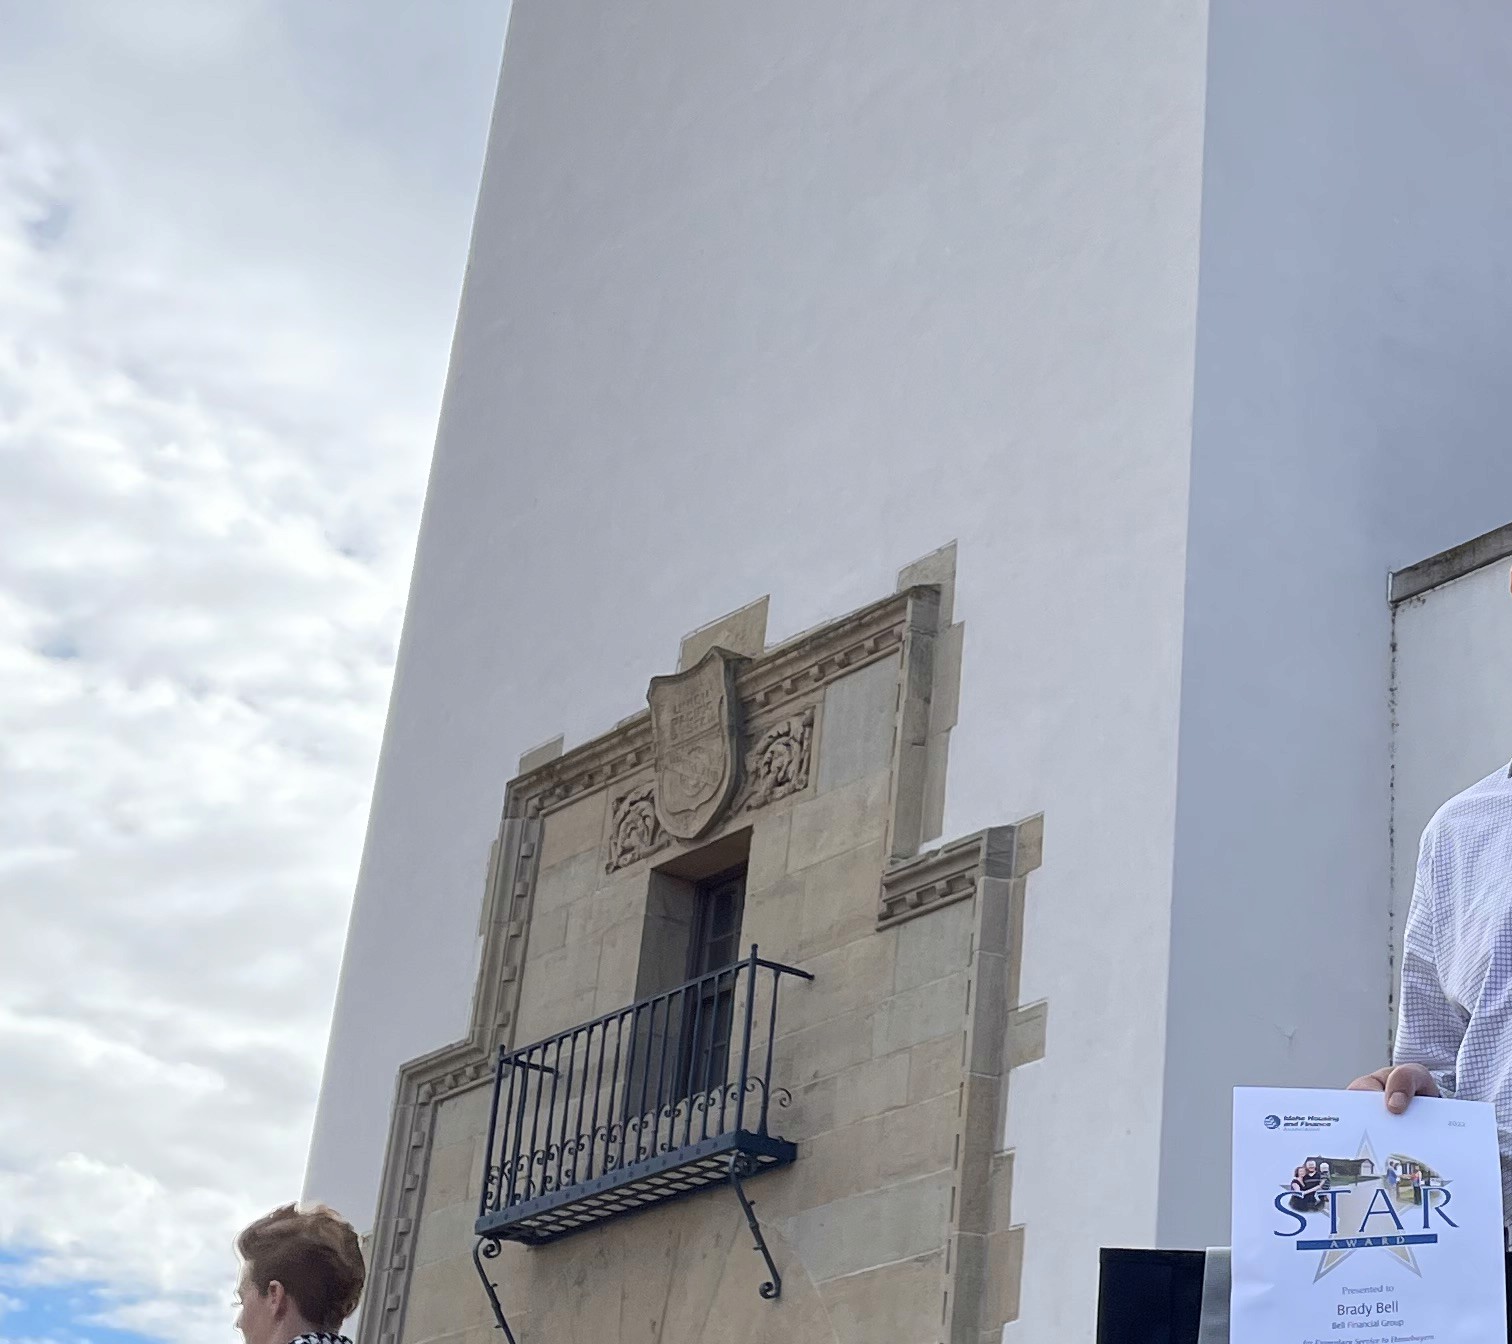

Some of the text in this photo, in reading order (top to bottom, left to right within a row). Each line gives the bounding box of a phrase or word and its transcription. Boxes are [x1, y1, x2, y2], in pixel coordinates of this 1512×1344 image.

[1273, 1186, 1460, 1237] STAR
[1329, 1236, 1406, 1249] AWARD
[1341, 1285, 1384, 1295] Presented
[1337, 1301, 1399, 1318] Brady Bell
[1332, 1319, 1405, 1330] Bell Financial Group
[1381, 1336, 1389, 1344] to
